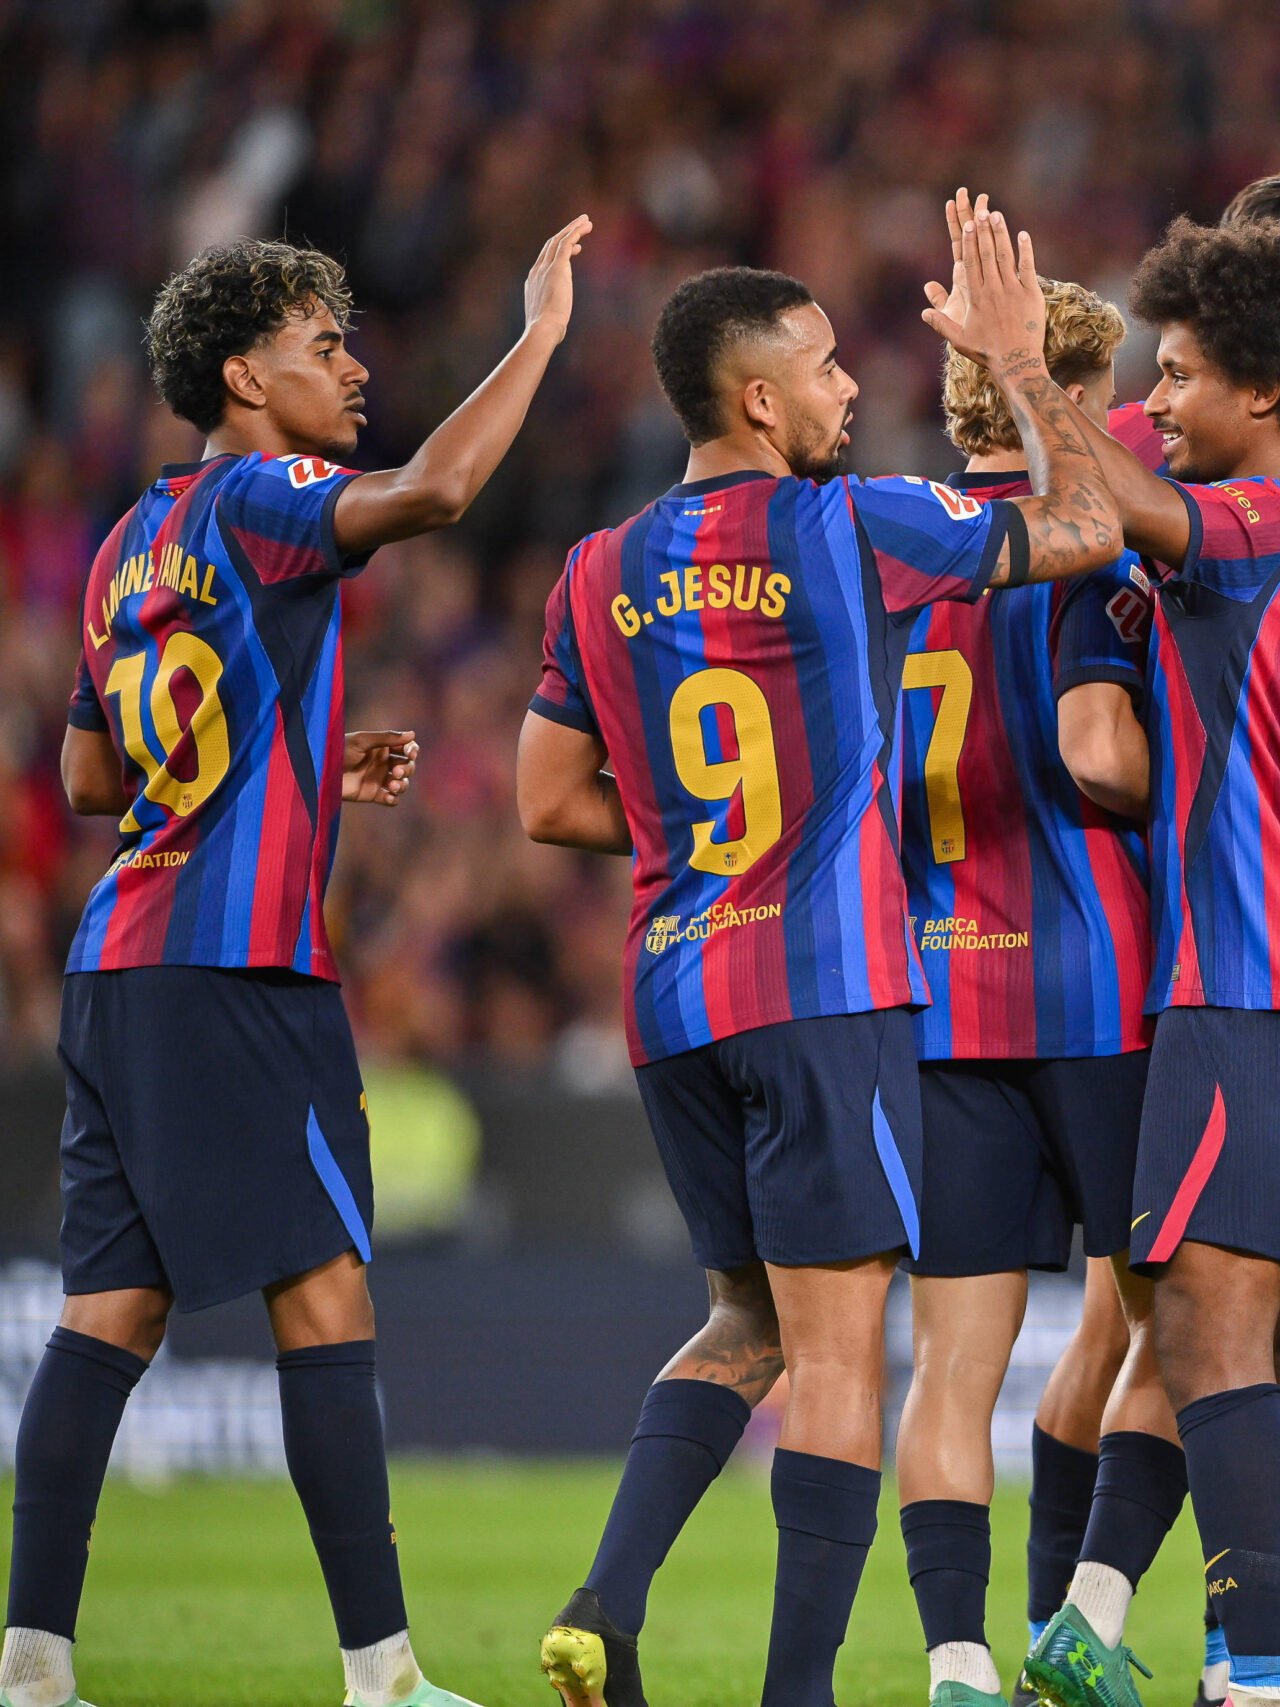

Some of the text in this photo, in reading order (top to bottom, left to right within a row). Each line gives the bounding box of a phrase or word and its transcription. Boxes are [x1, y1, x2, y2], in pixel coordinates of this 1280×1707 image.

[656, 563, 792, 619] JESUS
[104, 631, 230, 834] 10
[669, 667, 783, 877] 9
[901, 649, 974, 865] 7
[920, 931, 1029, 951] FOUNDATION
[923, 917, 979, 935] BARÇA
